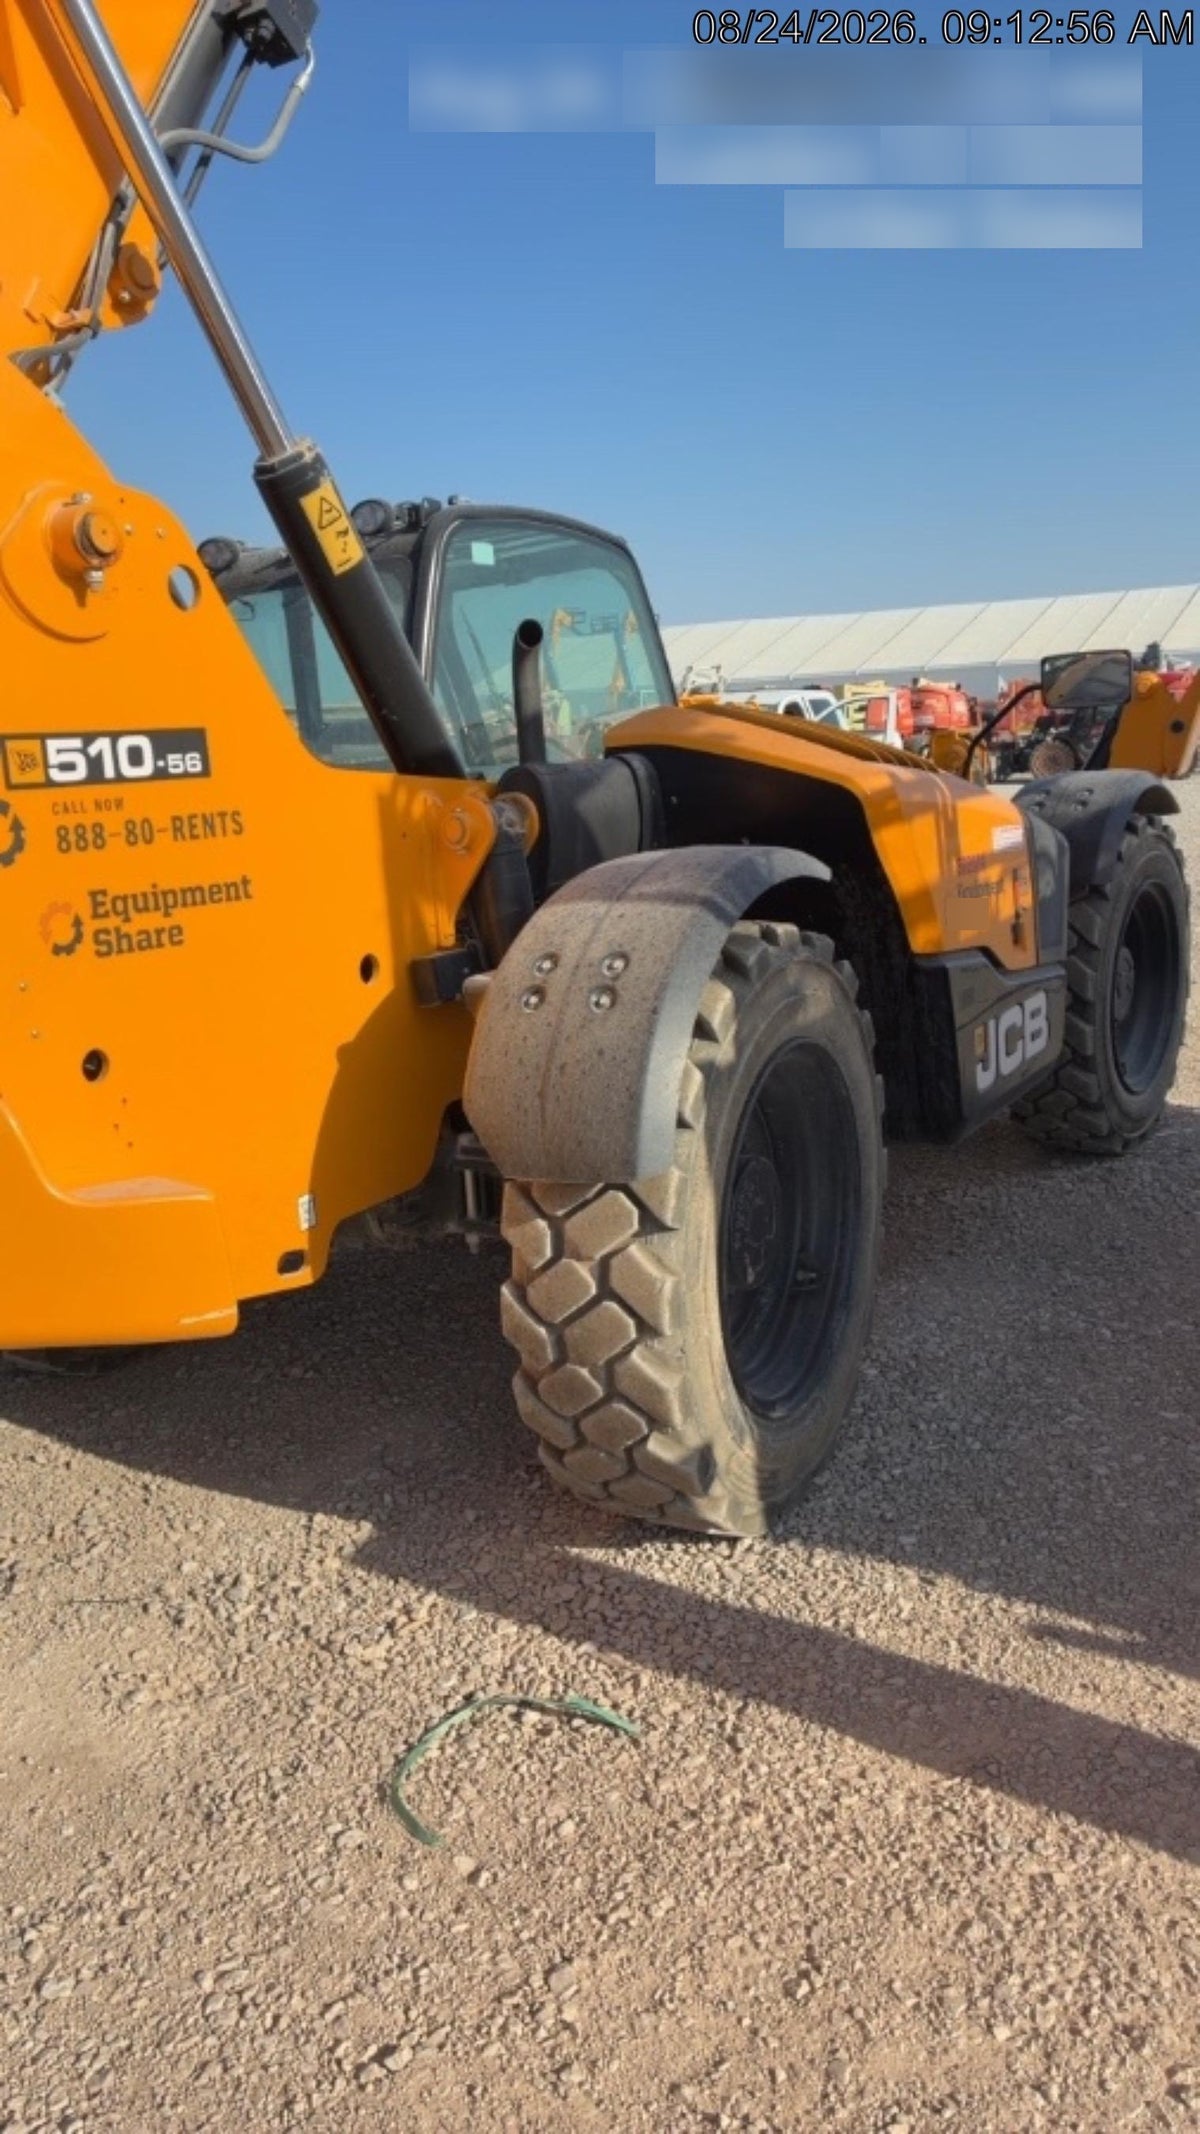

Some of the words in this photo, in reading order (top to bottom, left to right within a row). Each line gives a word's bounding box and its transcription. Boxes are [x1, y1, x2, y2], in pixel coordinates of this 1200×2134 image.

[52, 799, 87, 816] CALL
[94, 798, 124, 812] NOW
[56, 811, 244, 854] 888-80-RENTS
[88, 875, 253, 923] Equipment
[92, 924, 184, 958] Share
[975, 990, 1049, 1093] JCB
